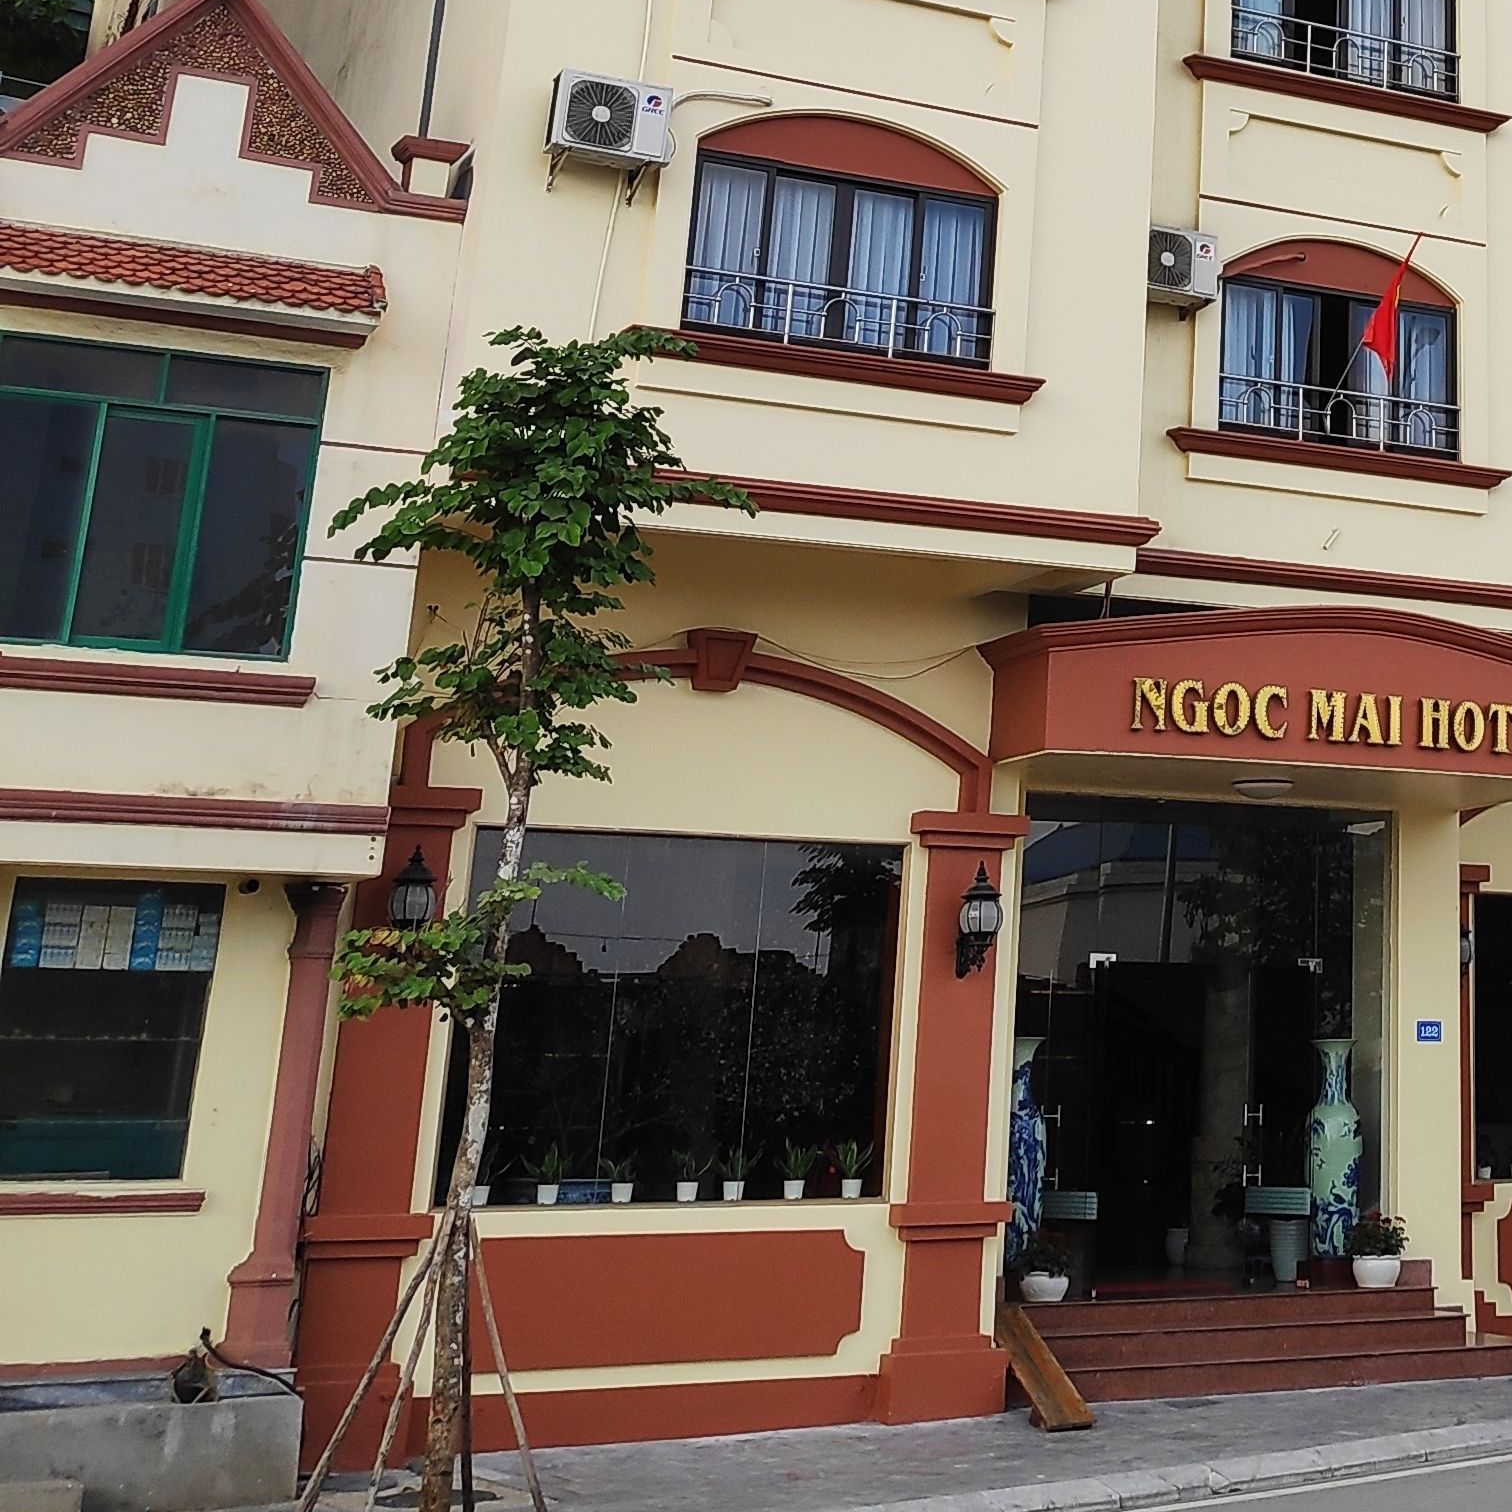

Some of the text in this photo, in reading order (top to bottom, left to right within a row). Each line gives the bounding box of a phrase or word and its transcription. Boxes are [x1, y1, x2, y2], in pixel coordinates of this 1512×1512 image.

[1130, 675, 1289, 740] NGOC
[1307, 688, 1404, 748] MAI
[1420, 1025, 1439, 1038] 122
